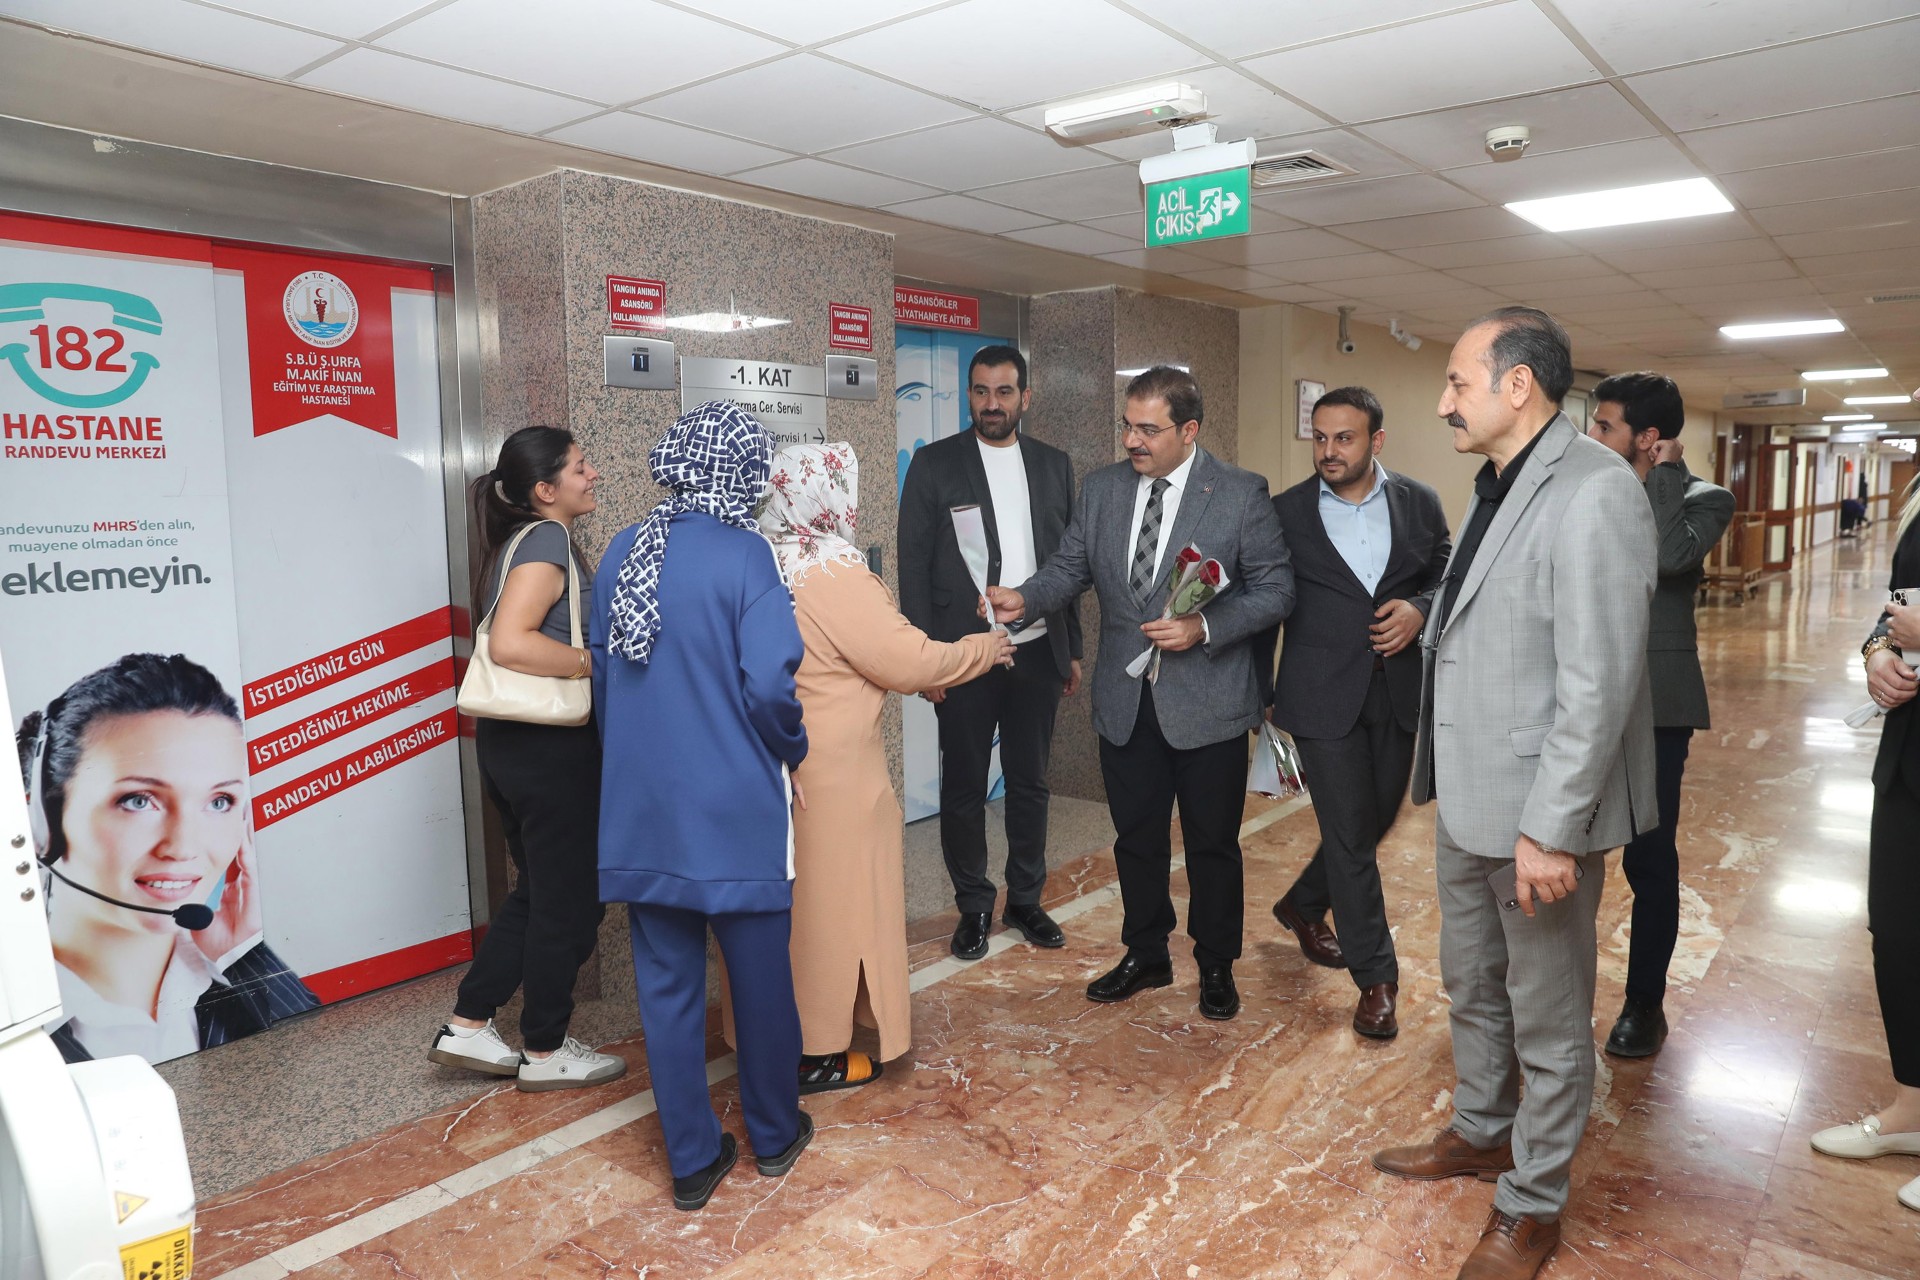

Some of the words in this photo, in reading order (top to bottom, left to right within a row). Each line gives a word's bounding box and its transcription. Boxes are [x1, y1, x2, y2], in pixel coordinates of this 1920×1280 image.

[1157, 186, 1193, 215] ACİL
[612, 284, 636, 294] YANGIN
[637, 287, 660, 297] ANINDA
[620, 299, 653, 310] ASANSÖRÜ
[896, 292, 906, 303] BU
[908, 294, 958, 310] ASANSÖRLER
[833, 310, 850, 320] YANGIN
[851, 312, 868, 322] ANINDA
[894, 306, 948, 323] ELİYATHANEYE
[949, 313, 971, 326] AİTTİR
[839, 323, 863, 332] ASANSÖRÜ
[833, 334, 869, 344] KULLANMAYINIZ
[30, 324, 127, 372] 182
[285, 352, 317, 365] S.B.Ü
[320, 355, 361, 369] Ş.URFA
[286, 367, 329, 381] M.AKİF
[332, 368, 362, 382] İNAN
[730, 366, 752, 385] -1.
[758, 367, 792, 387] KAT
[273, 380, 307, 392] EĞİTİM
[309, 384, 321, 393] VE
[323, 385, 376, 396] ARAŞTIRMA
[301, 395, 351, 405] HASTANESİ
[759, 400, 775, 413] Cer.
[777, 401, 803, 415] Servisi
[3, 413, 163, 441] HASTANE
[803, 433, 807, 443] 1
[5, 445, 91, 459] RANDEVU
[96, 444, 166, 459] MERKEZİ
[0, 523, 90, 536] andevunuzu
[168, 518, 195, 531] alın,
[8, 541, 78, 554] muayene
[82, 537, 143, 550] olmadan
[146, 536, 178, 547] önce
[1, 556, 211, 596] eklemeyin.
[248, 655, 346, 707] İSTEDİĞİNİZ
[348, 640, 385, 666] GÜN
[253, 709, 351, 764] İSTEDİĞİNİZ
[351, 682, 412, 720] HEKİME
[262, 769, 341, 819] RANDEVU
[346, 720, 446, 780] ALABİLİRSİNİZ
